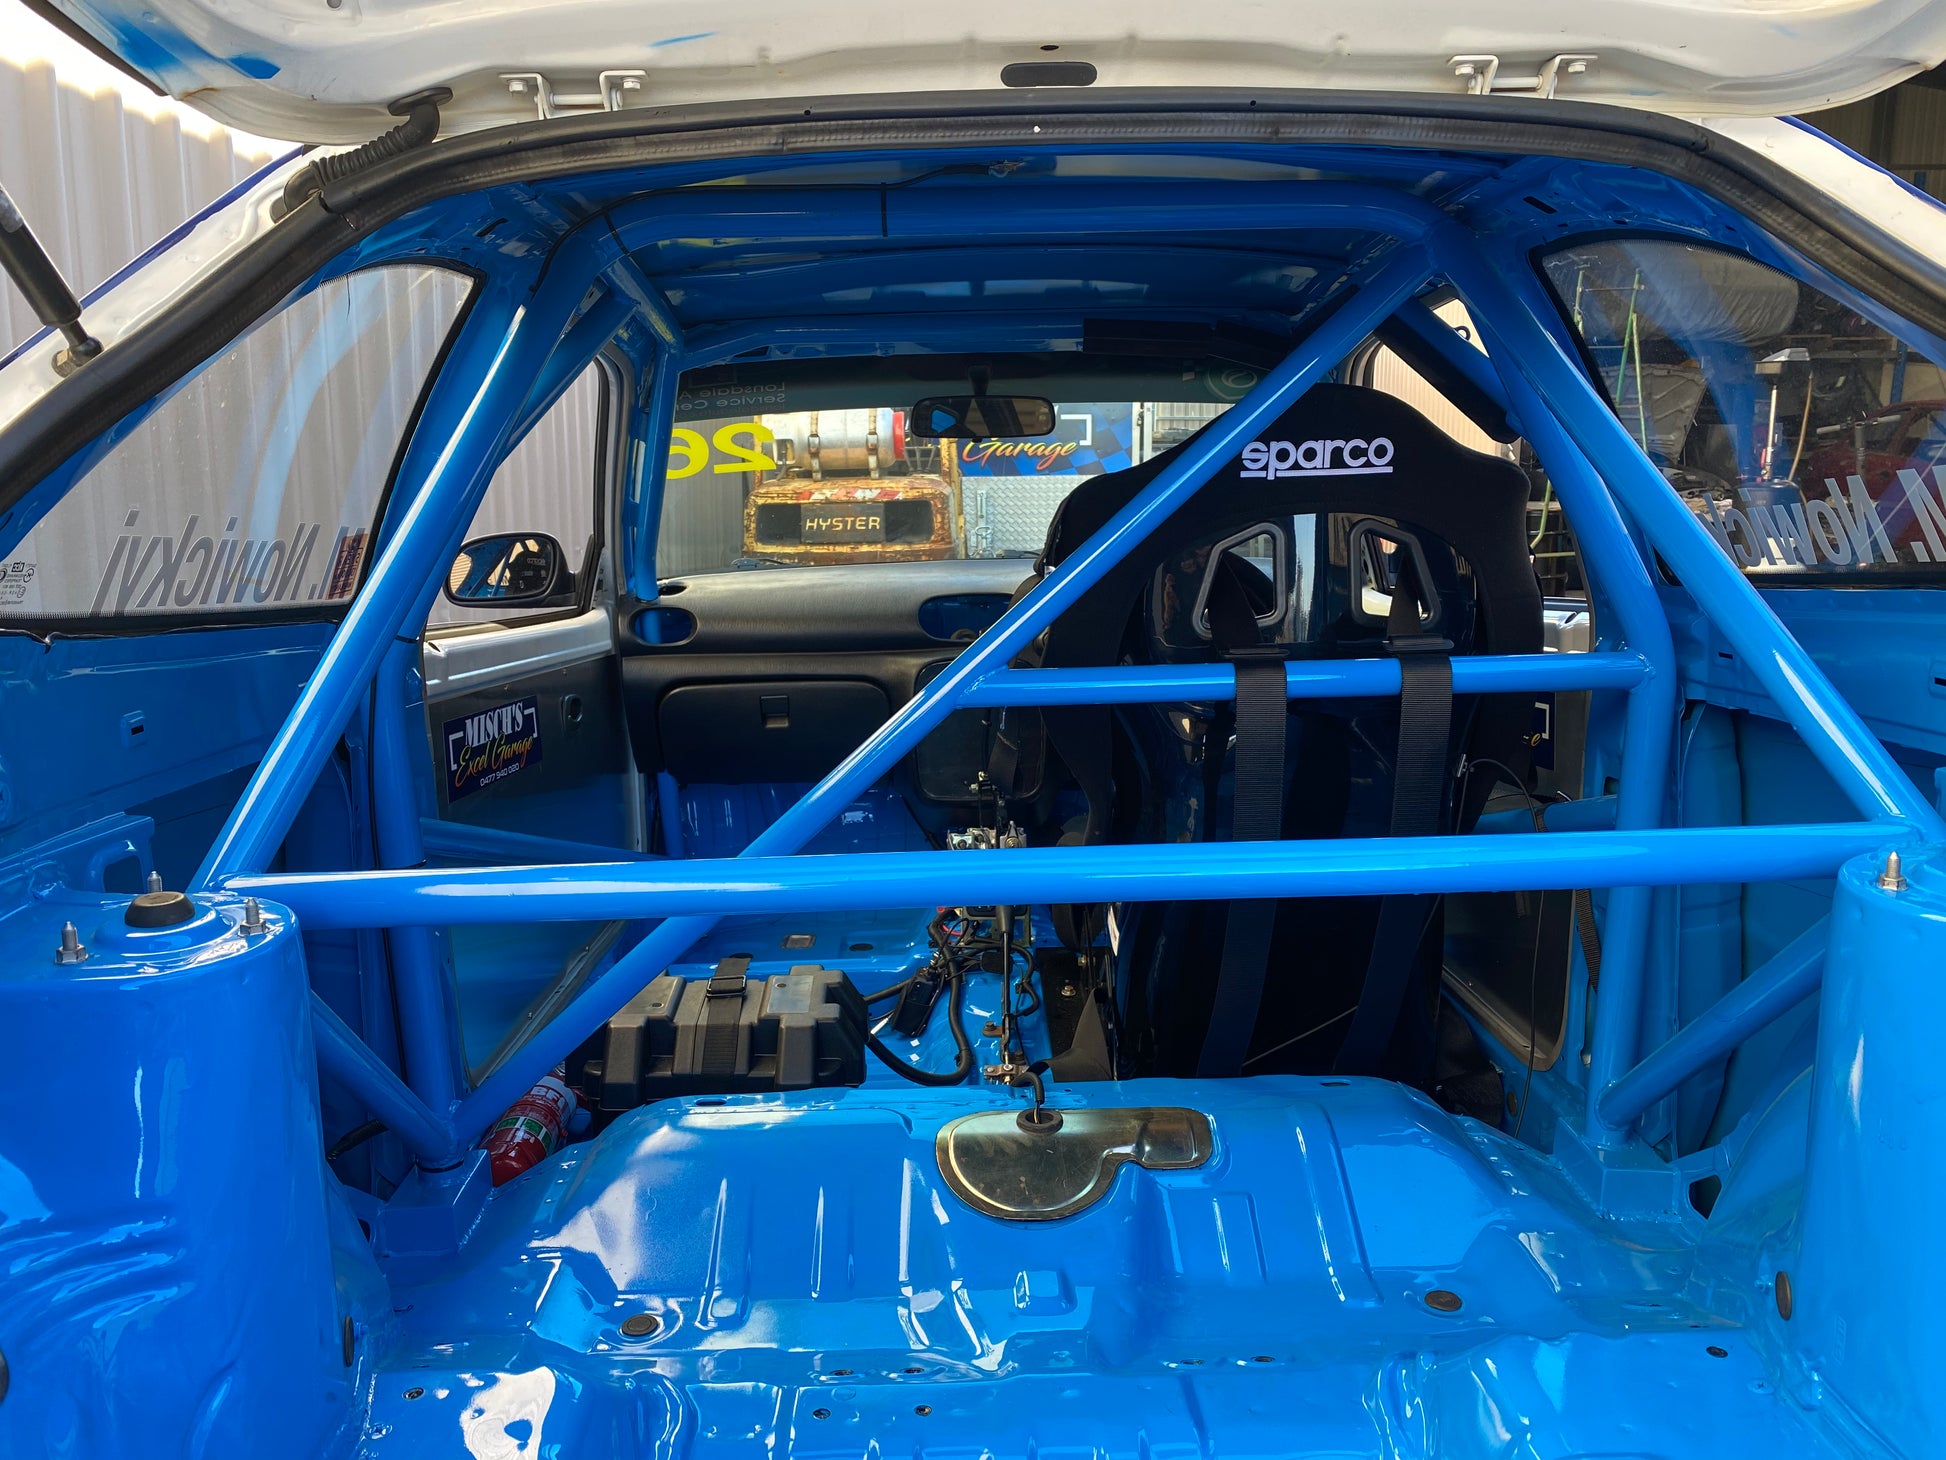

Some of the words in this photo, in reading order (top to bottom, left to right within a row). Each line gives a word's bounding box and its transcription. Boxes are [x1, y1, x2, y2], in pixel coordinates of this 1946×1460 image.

[961, 437, 1078, 471] Garage
[1241, 437, 1395, 480] sparco
[806, 516, 881, 531] HYSTER
[465, 702, 523, 748] MISCH'S
[455, 740, 491, 788] Excel
[491, 731, 534, 770] Garage
